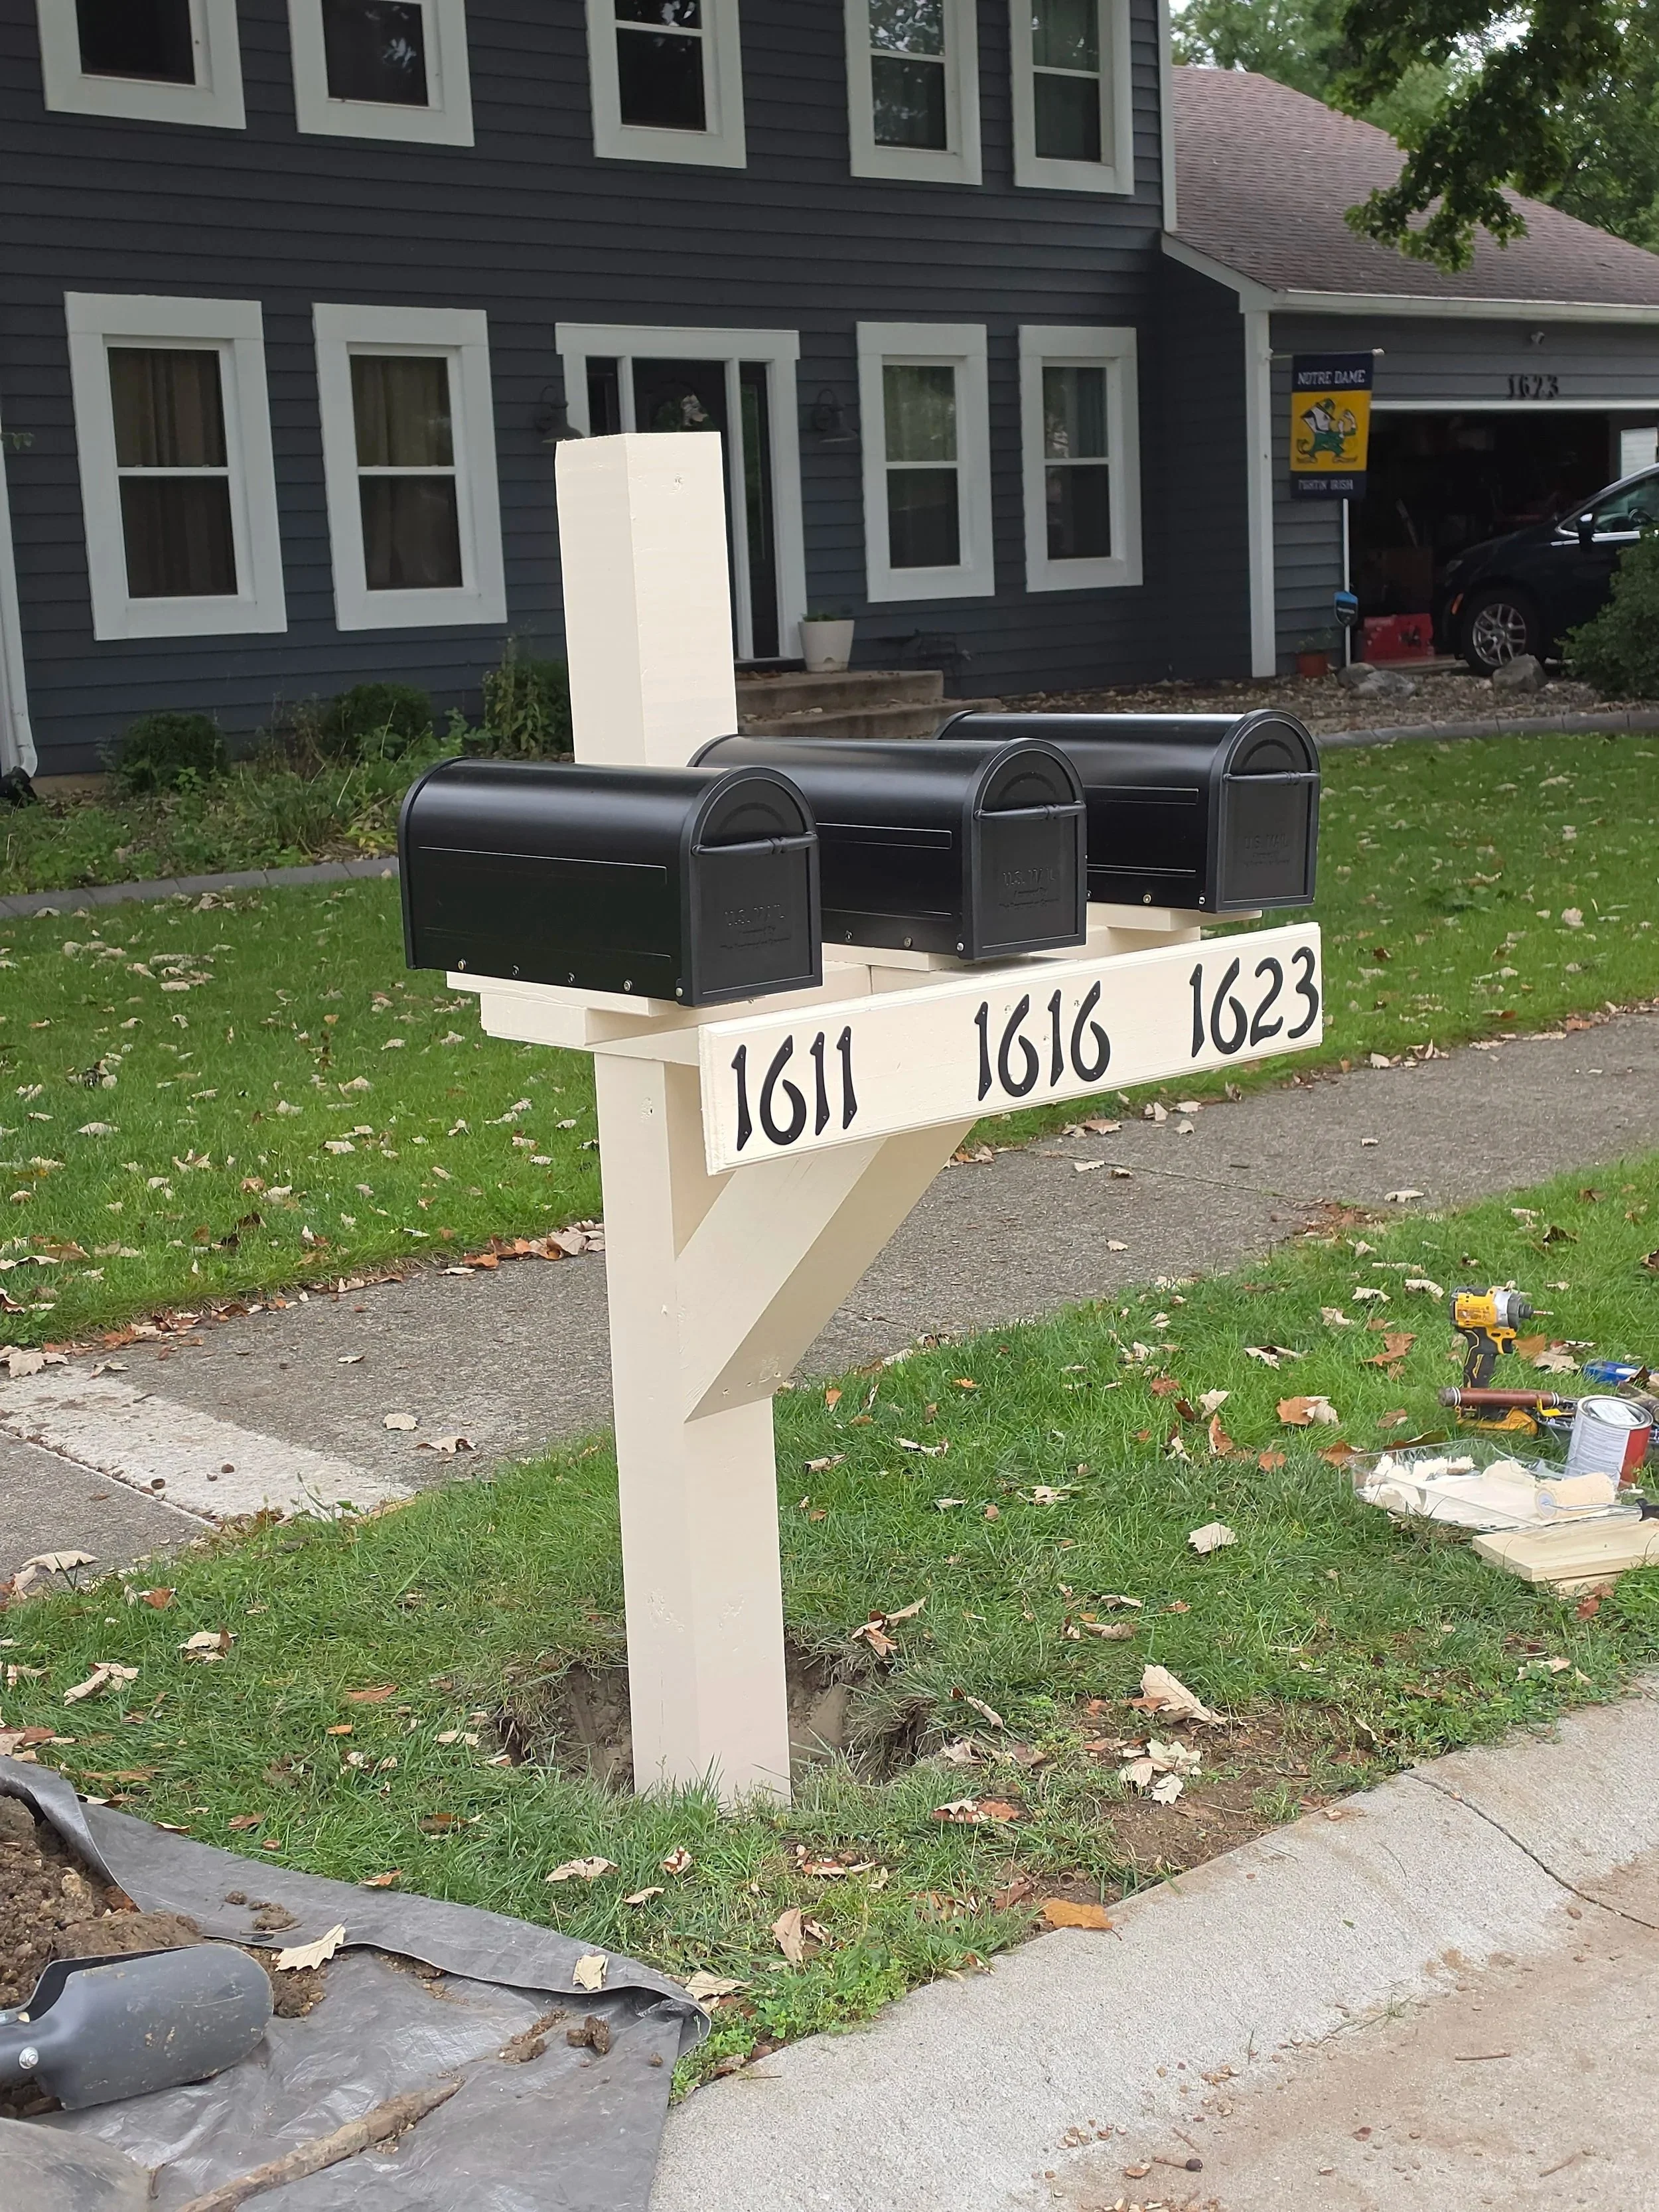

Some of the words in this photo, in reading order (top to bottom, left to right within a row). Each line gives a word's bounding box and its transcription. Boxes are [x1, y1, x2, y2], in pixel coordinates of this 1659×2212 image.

[1297, 370, 1333, 385] NOTRE
[1334, 369, 1366, 384] DAME
[1329, 479, 1354, 491] IRISH
[731, 1026, 857, 1152] 1611
[974, 980, 1112, 1102] 1616
[1189, 946, 1320, 1059] 1623
